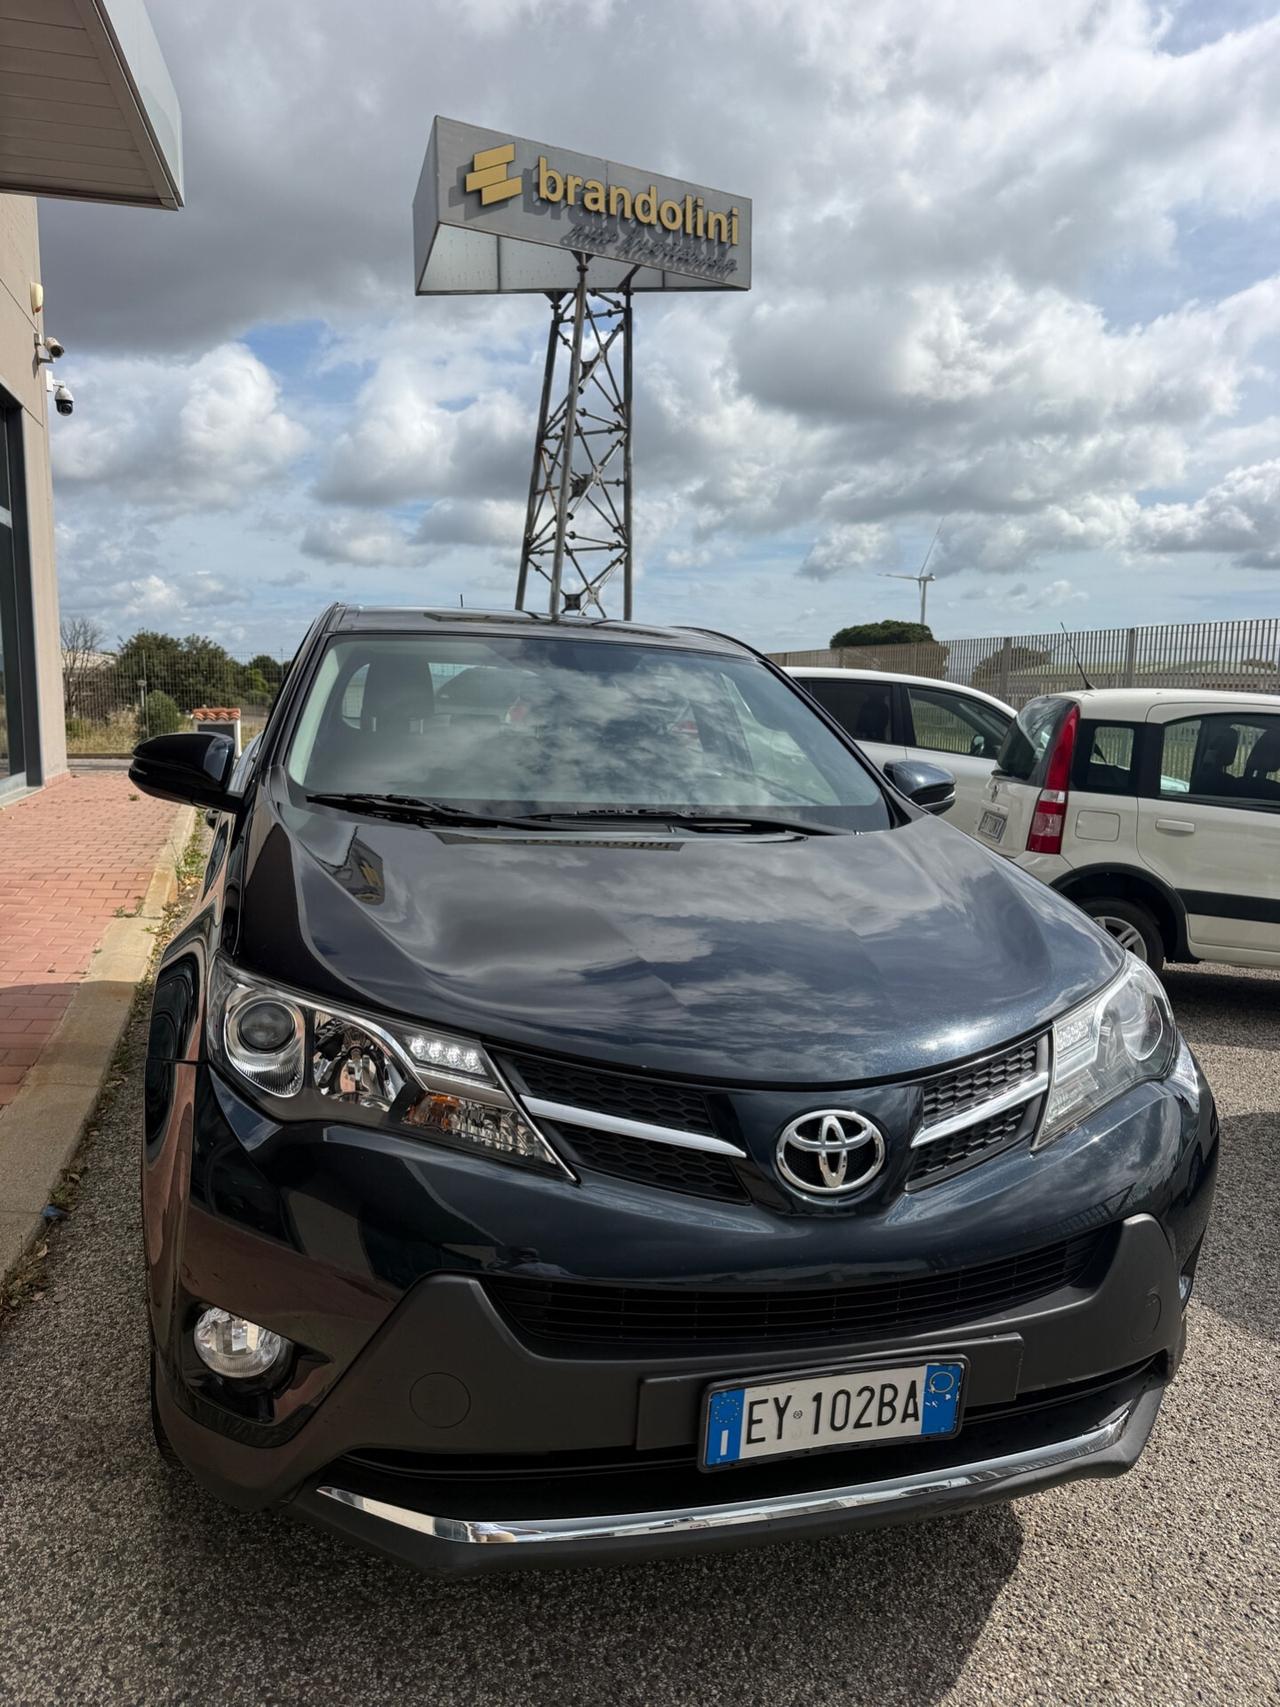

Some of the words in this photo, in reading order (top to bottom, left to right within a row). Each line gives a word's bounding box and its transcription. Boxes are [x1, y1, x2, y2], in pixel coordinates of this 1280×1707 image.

[538, 155, 739, 246] brandolini
[719, 1429, 729, 1456] I
[745, 1394, 793, 1445] EY
[811, 1379, 920, 1435] 102BA
